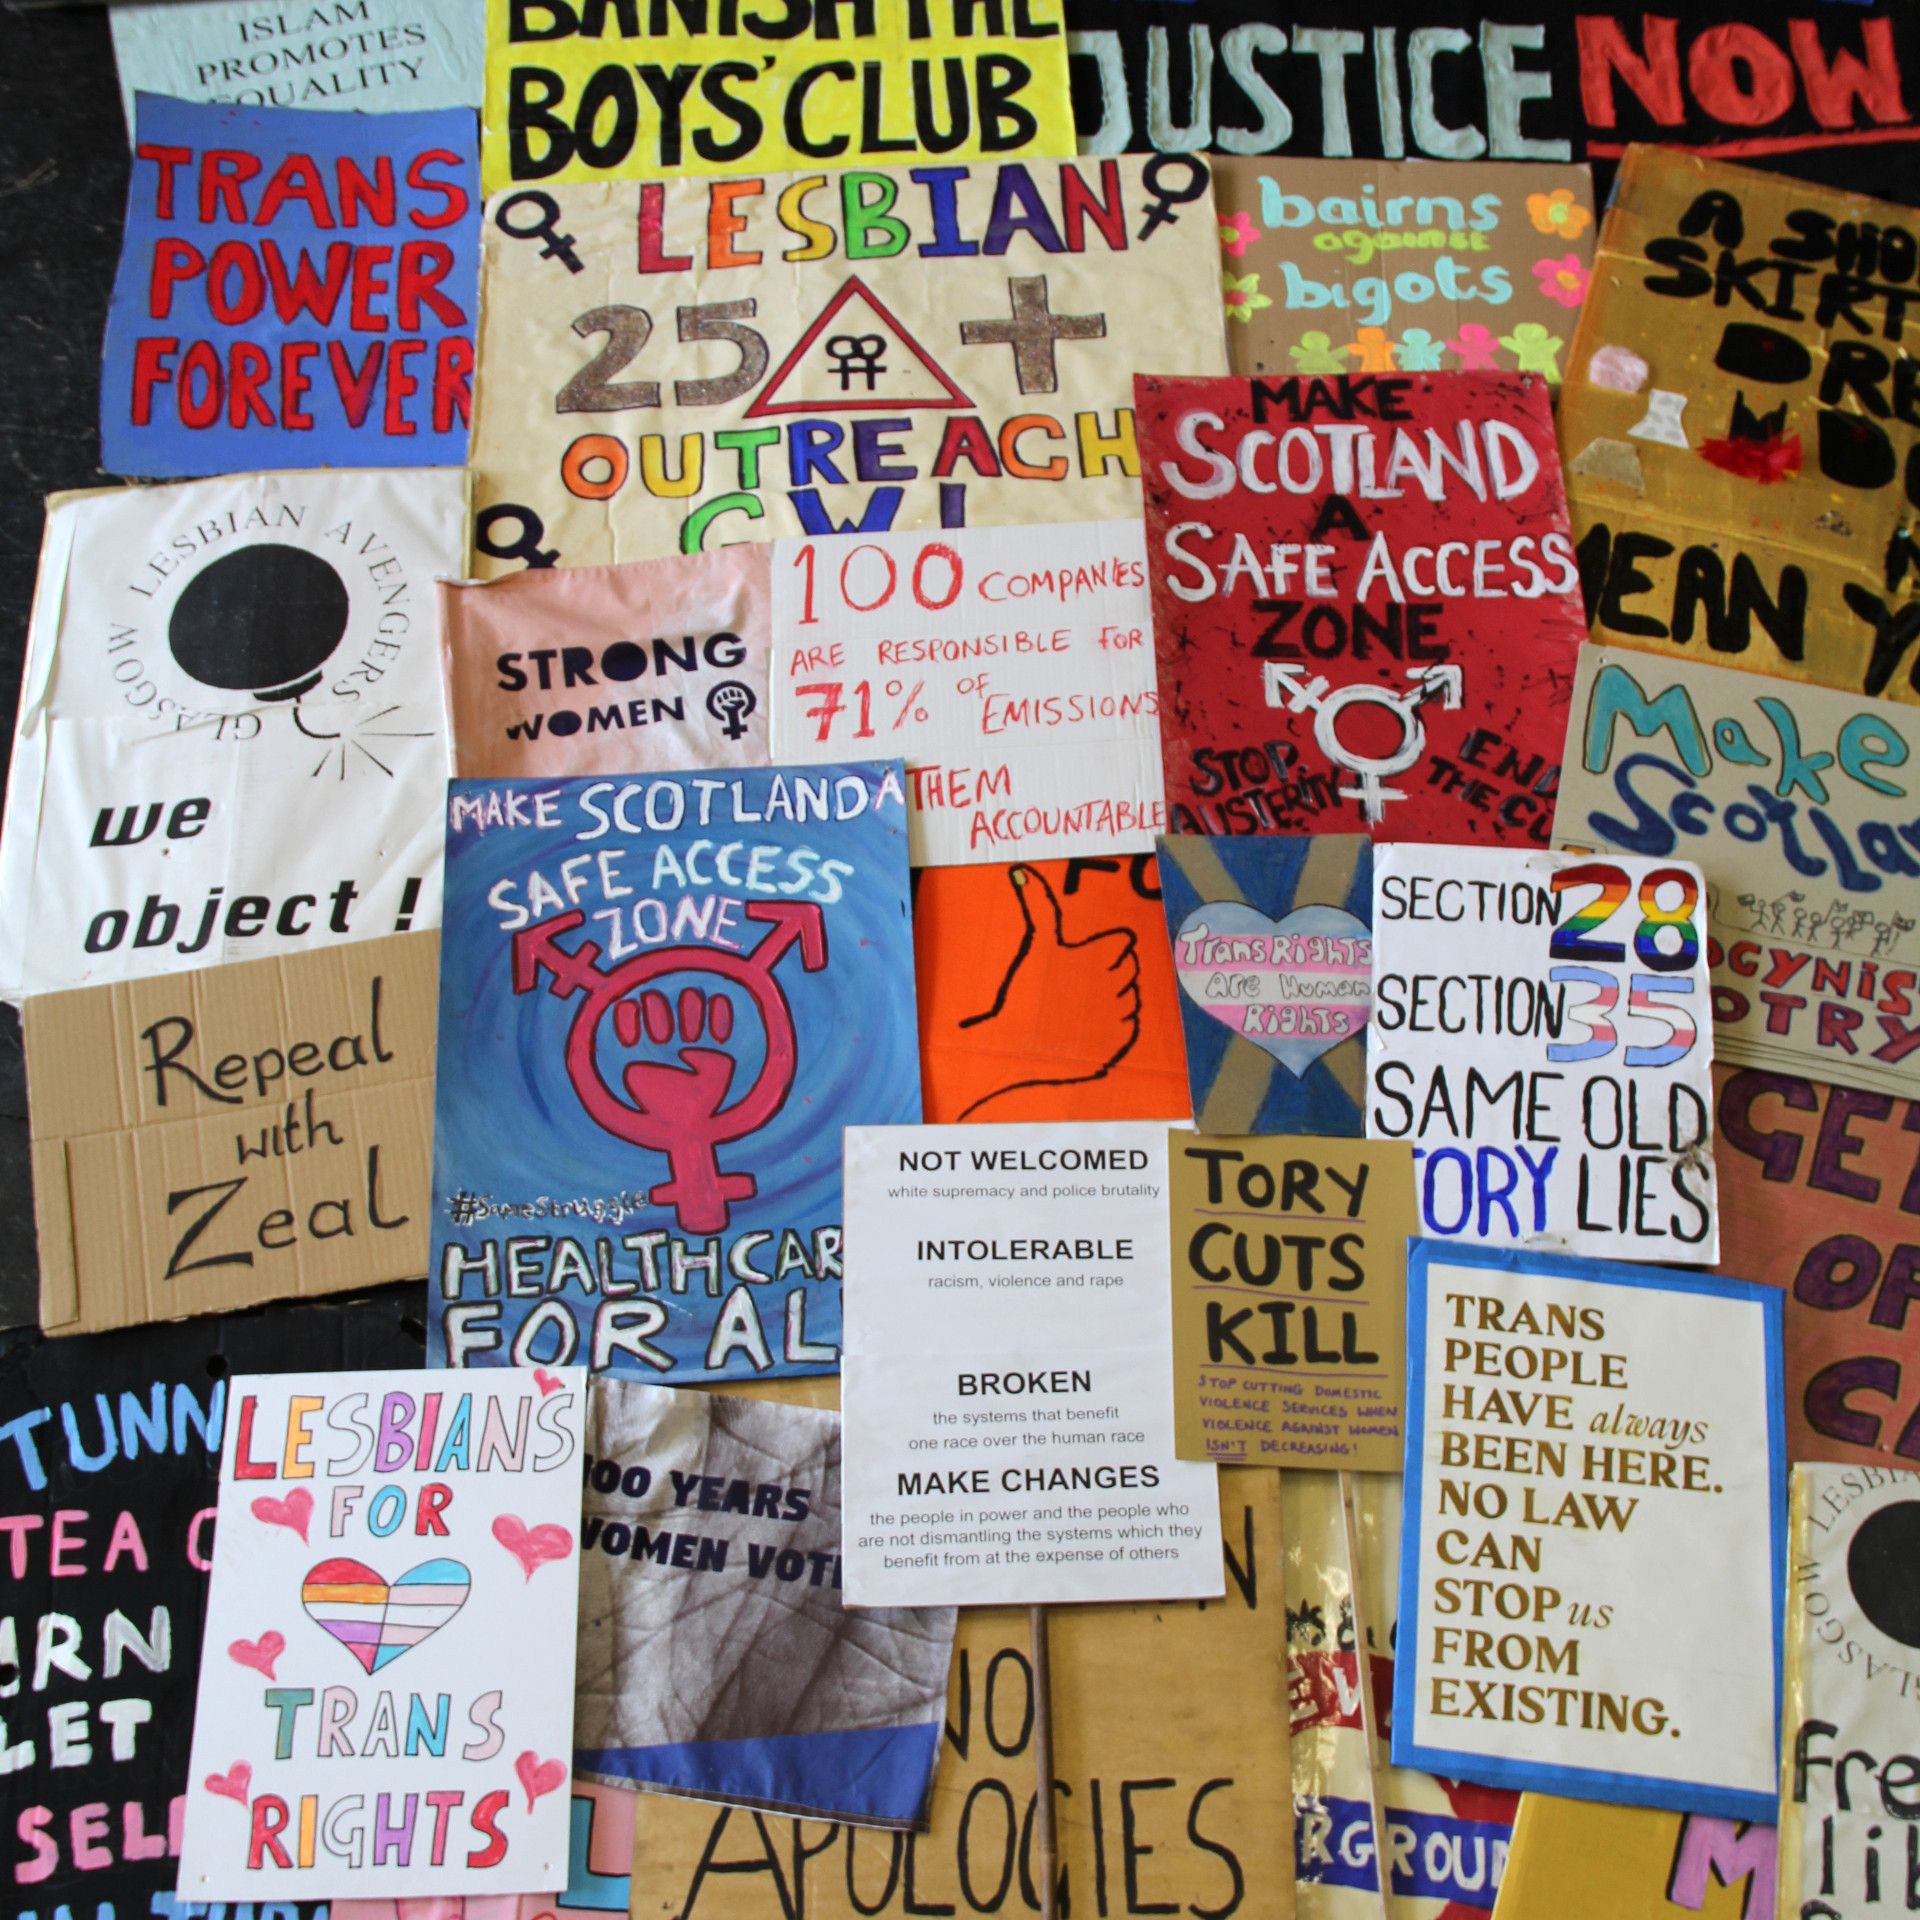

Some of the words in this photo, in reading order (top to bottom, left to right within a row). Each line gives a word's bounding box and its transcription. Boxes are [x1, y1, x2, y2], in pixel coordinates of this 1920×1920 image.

[240, 1, 371, 43] ISLAM
[197, 23, 426, 86] PROMOTES
[508, 55, 776, 181] BOYS'
[784, 54, 1037, 158] CLUB
[1070, 19, 1573, 161] JUSTICE
[1576, 13, 1912, 129] NOW
[137, 144, 468, 229] TRANS
[638, 159, 1129, 274] LESBIAN
[1257, 175, 1502, 232] bairns
[1313, 229, 1491, 266] against
[1678, 189, 1744, 250] A
[150, 237, 468, 332] POWER
[1280, 255, 1513, 326] bigots
[1644, 237, 1920, 341] SKIRT
[131, 336, 475, 435] FOREVER
[555, 298, 770, 414] 25
[1250, 376, 1413, 423] MAKE
[561, 407, 1140, 499] OUTREACH
[1160, 411, 1539, 501] SCOTLAND
[1311, 495, 1370, 542] A
[129, 503, 308, 598] LESBIAN
[1165, 521, 1339, 602] SAFE
[1356, 531, 1578, 603] ACCESS
[325, 519, 411, 704] AVENGERS
[794, 543, 964, 625] 100
[978, 557, 1145, 602] COMPANIES
[790, 643, 845, 676] ARE
[878, 629, 1073, 666] RESPONSIBLE
[1098, 627, 1144, 651] FOR
[1251, 599, 1451, 661] ZONE
[497, 632, 747, 691] STRONG
[506, 697, 685, 740] WOMEN
[795, 680, 929, 742] 71%
[957, 673, 990, 698] OF
[982, 691, 1161, 735] EMISSIONS
[1583, 664, 1909, 805] Make
[906, 764, 1011, 811] THEM
[1189, 740, 1298, 796] STOP
[1427, 755, 1500, 812] THE
[89, 797, 211, 847] we
[450, 789, 562, 834] MAKE
[576, 773, 871, 841] SCOTLAND
[970, 799, 1167, 850] ACCOUNTABLE
[488, 849, 633, 931] SAFE
[652, 839, 855, 903] ACCESS
[592, 895, 745, 961] ZONE
[1180, 922, 1265, 965] Trans
[1381, 876, 1562, 926] SECTION
[1550, 863, 1699, 971] 28
[1279, 973, 1370, 999] Human
[1377, 974, 1566, 1039] SECTION
[1547, 965, 1697, 1067] 35
[141, 976, 394, 1106] Repeal
[237, 1087, 343, 1165] with
[1374, 1061, 1564, 1143] SAME
[1583, 1075, 1709, 1154] OLD
[900, 1151, 961, 1171] NOT
[971, 1149, 1148, 1171] WELCOMED
[1185, 1148, 1369, 1217] TORY
[164, 1145, 409, 1280] Zeal
[888, 1184, 928, 1198] white
[932, 1185, 1015, 1200] supremacy
[1020, 1184, 1047, 1197] and
[1052, 1184, 1097, 1200] police
[1101, 1183, 1160, 1199] brutality
[1412, 1145, 1559, 1236] ORY
[1577, 1153, 1710, 1243] LIES
[917, 1239, 1134, 1261] INTOLERABLE
[1189, 1222, 1365, 1291] CUTS
[928, 1274, 984, 1289] racism,
[988, 1273, 1051, 1287] violence
[1056, 1273, 1085, 1287] and
[1089, 1275, 1123, 1290] rape
[443, 1298, 678, 1374] FOR
[1207, 1301, 1379, 1365] KILL
[1446, 1292, 1605, 1341] TRANS
[958, 1371, 1092, 1396] BROKEN
[1198, 1375, 1237, 1390] STOP
[1243, 1380, 1303, 1395] CUTTING
[1315, 1386, 1382, 1399] DOMESTIC
[1444, 1338, 1628, 1389] PEOPLE
[234, 1391, 575, 1480] LESBIANS
[933, 1411, 959, 1425] the
[962, 1410, 1027, 1426] systems
[1032, 1408, 1062, 1422] that
[1066, 1406, 1119, 1421] benefit
[1200, 1397, 1270, 1412] VIOLENCE
[1283, 1401, 1347, 1418] SERVICES
[1357, 1406, 1398, 1417] WHEN
[1202, 1418, 1272, 1433] VIOLENCE
[1281, 1421, 1340, 1435] AGAINST
[1349, 1425, 1399, 1437] WOMEN
[1442, 1384, 1573, 1430] HAVE
[1589, 1402, 1709, 1450] always
[909, 1438, 938, 1450] one
[944, 1436, 979, 1449] race
[983, 1435, 1017, 1447] over
[1021, 1432, 1047, 1446] the
[1052, 1431, 1106, 1445] human
[1111, 1430, 1145, 1443] race
[1441, 1430, 1568, 1479] BEEN
[1582, 1444, 1723, 1493] HERE.
[330, 1482, 453, 1537] FOR
[669, 1469, 812, 1522] YEARS
[898, 1471, 990, 1496] MAKE
[1001, 1465, 1160, 1493] CHANGES
[1438, 1479, 1508, 1518] NO
[1522, 1487, 1639, 1533] LAW
[858, 1534, 884, 1547] are
[890, 1532, 916, 1546] not
[920, 1529, 1012, 1547] dismantling
[1017, 1528, 1042, 1542] the
[1047, 1527, 1113, 1543] systems
[1117, 1524, 1164, 1539] which
[1169, 1523, 1202, 1540] they
[870, 1511, 896, 1526] the
[900, 1510, 954, 1527] people
[960, 1508, 974, 1523] in
[979, 1508, 1029, 1524] power
[1033, 1506, 1062, 1520] and
[1068, 1505, 1093, 1519] the
[1097, 1504, 1151, 1521] people
[1156, 1502, 1189, 1517] who
[884, 1553, 939, 1569] benefit
[944, 1552, 980, 1567] from
[985, 1552, 1000, 1565] at
[1005, 1549, 1031, 1563] the
[1036, 1549, 1104, 1565] expense
[1109, 1546, 1125, 1560] of
[1129, 1545, 1179, 1560] others
[1436, 1528, 1542, 1573] CAN
[1433, 1577, 1561, 1623] STOP
[1568, 1600, 1614, 1628] us
[1432, 1626, 1580, 1676] FROM
[264, 1685, 505, 1761] TRANS
[1429, 1677, 1680, 1738] EXISTING.
[247, 1790, 510, 1869] RIGHTS
